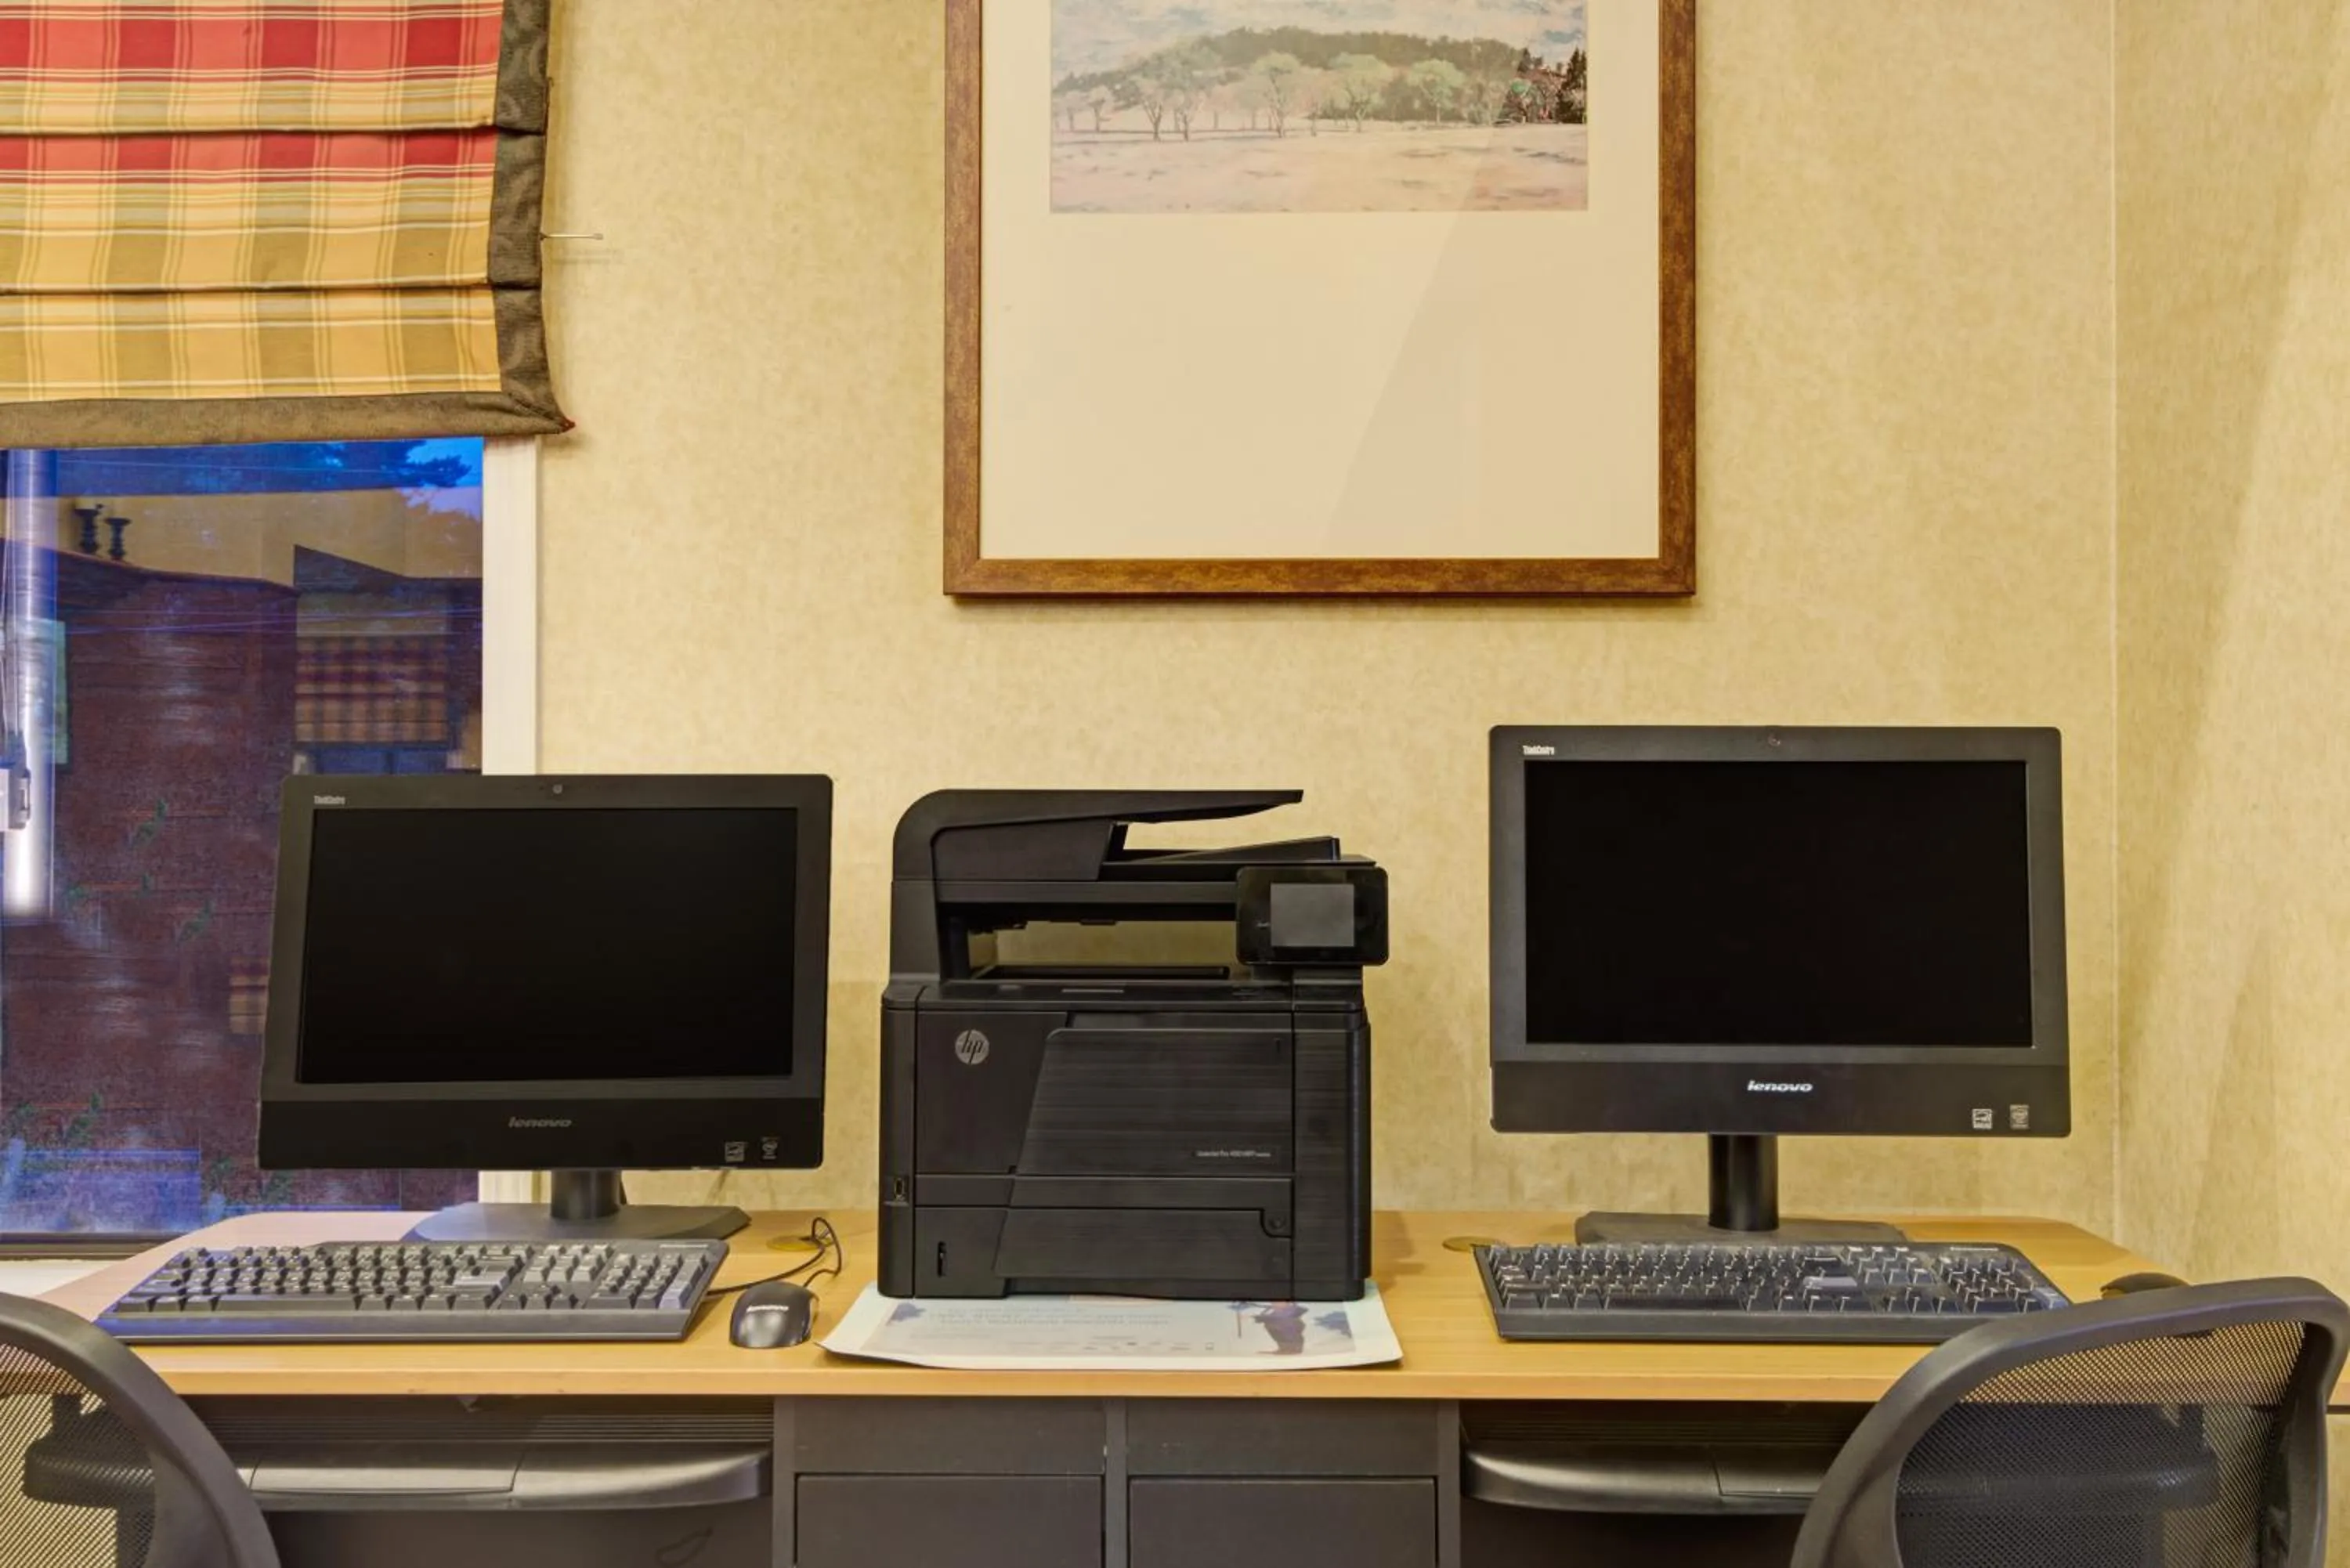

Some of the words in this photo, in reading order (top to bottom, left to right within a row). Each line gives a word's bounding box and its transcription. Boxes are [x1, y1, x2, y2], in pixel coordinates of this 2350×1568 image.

[960, 1029, 985, 1065] hp
[1747, 1079, 1813, 1093] lenovo
[508, 1116, 573, 1128] lenovo
